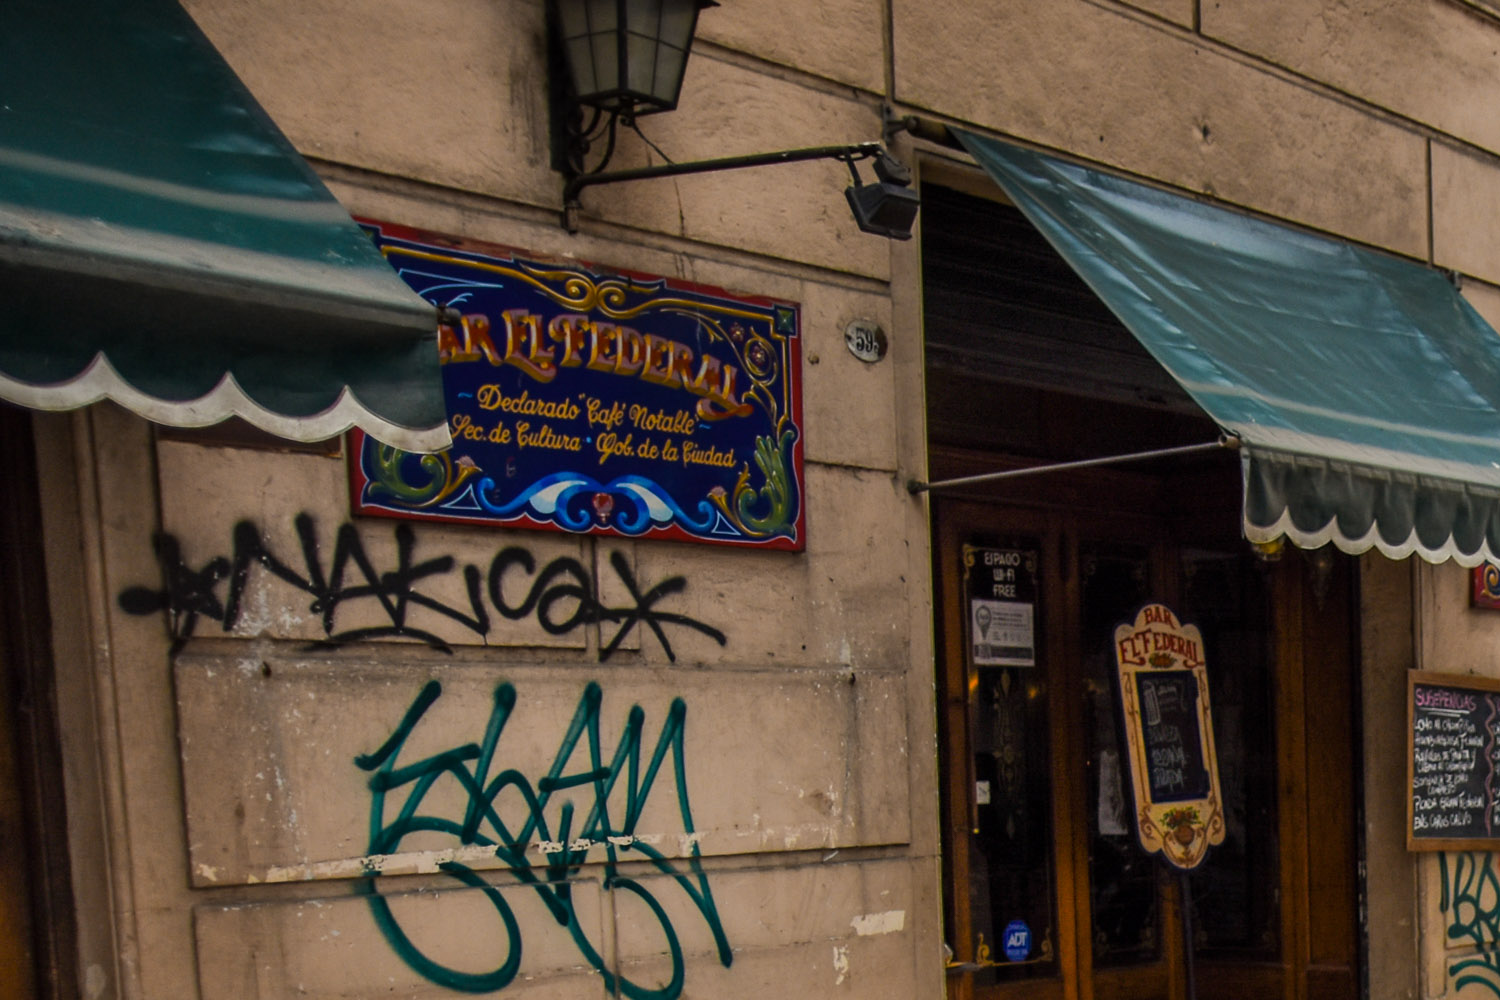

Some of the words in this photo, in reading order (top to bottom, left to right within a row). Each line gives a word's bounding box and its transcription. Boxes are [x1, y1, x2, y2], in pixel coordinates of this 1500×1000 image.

[437, 313, 503, 367] AR
[501, 309, 557, 383] EL
[547, 312, 754, 421] FEDERAL
[476, 384, 579, 420] Declarado
[516, 426, 582, 452] Cultura
[638, 440, 659, 460] de
[662, 443, 680, 462] la
[682, 440, 737, 468] Ciudad
[993, 584, 1017, 598] FREE
[1144, 606, 1175, 629] BAR
[1118, 632, 1147, 666] EL
[1134, 628, 1206, 668] FEDERAL
[1007, 931, 1028, 947] ADT
